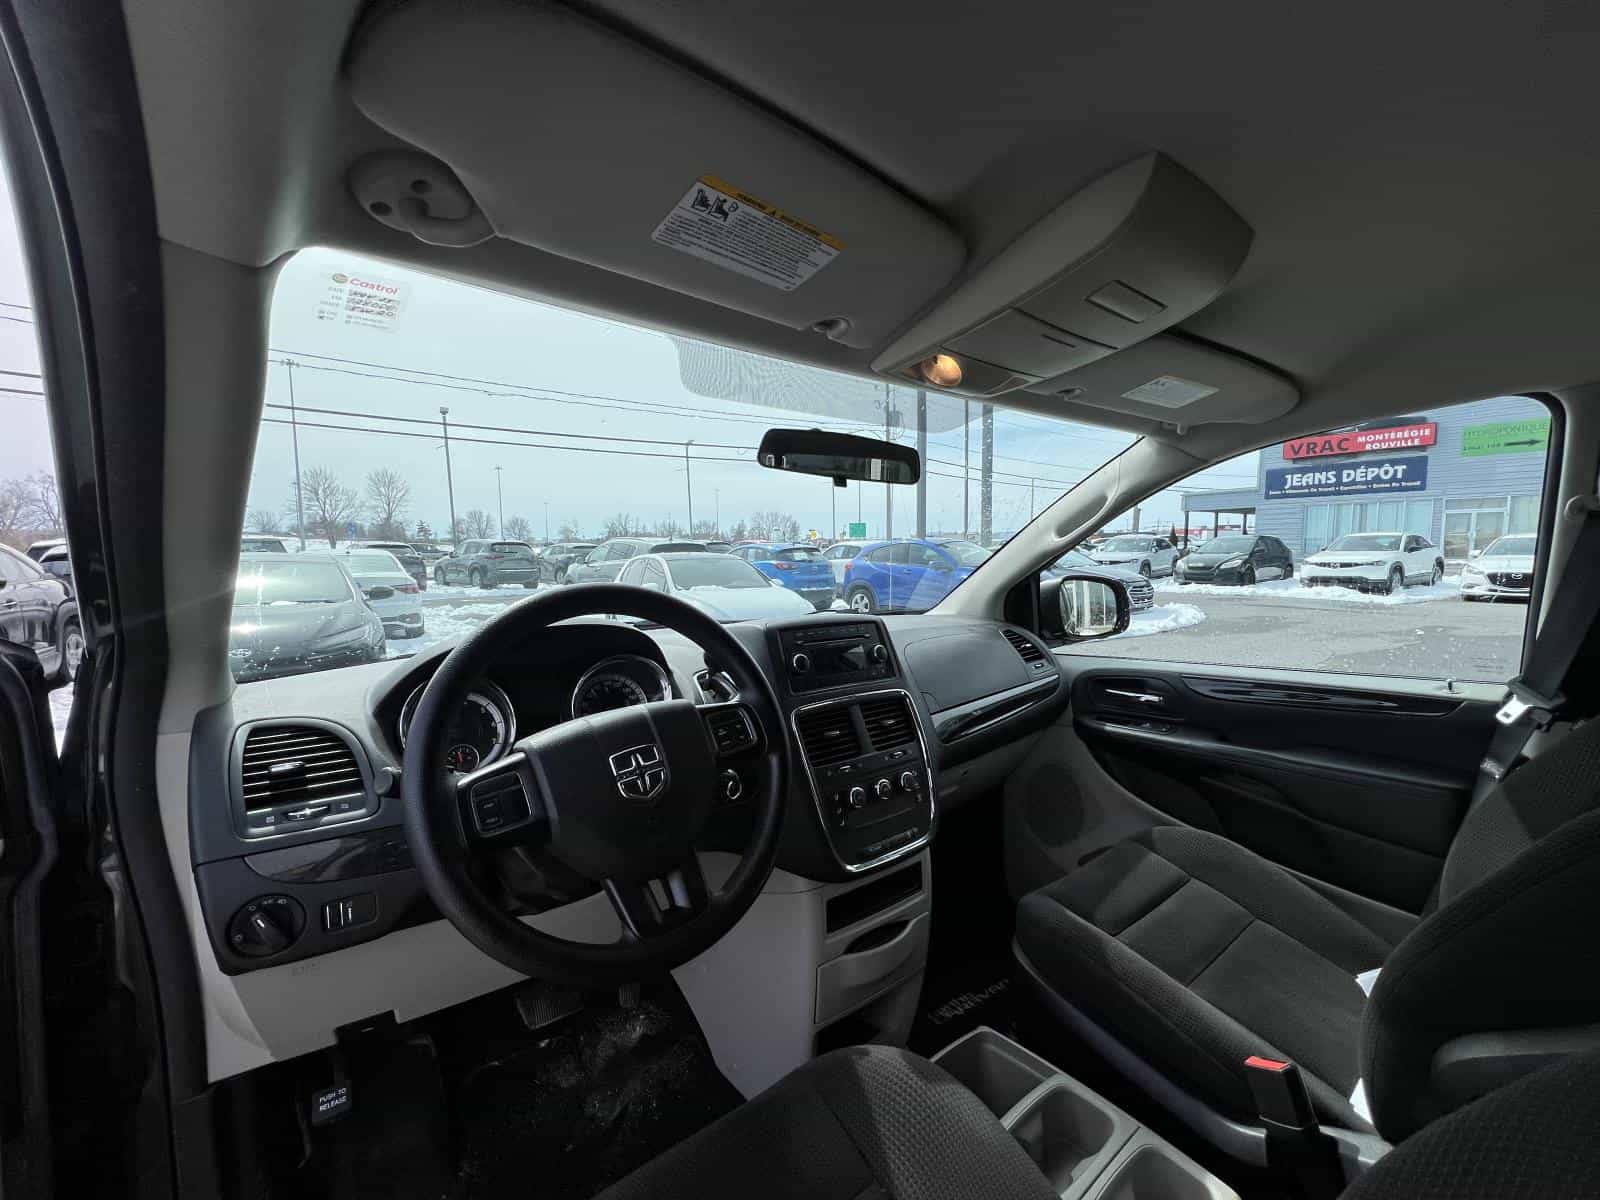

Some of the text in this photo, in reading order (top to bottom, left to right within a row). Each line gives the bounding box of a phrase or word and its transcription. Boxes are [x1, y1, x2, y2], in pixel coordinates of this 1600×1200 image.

[350, 278, 398, 295] Castrol
[1290, 438, 1351, 457] VRAC
[1365, 438, 1421, 450] ROUVILLE
[1285, 463, 1407, 489] JEANS DÉPÔT
[319, 1092, 336, 1103] PUSH
[319, 1095, 347, 1111] RELEASE
